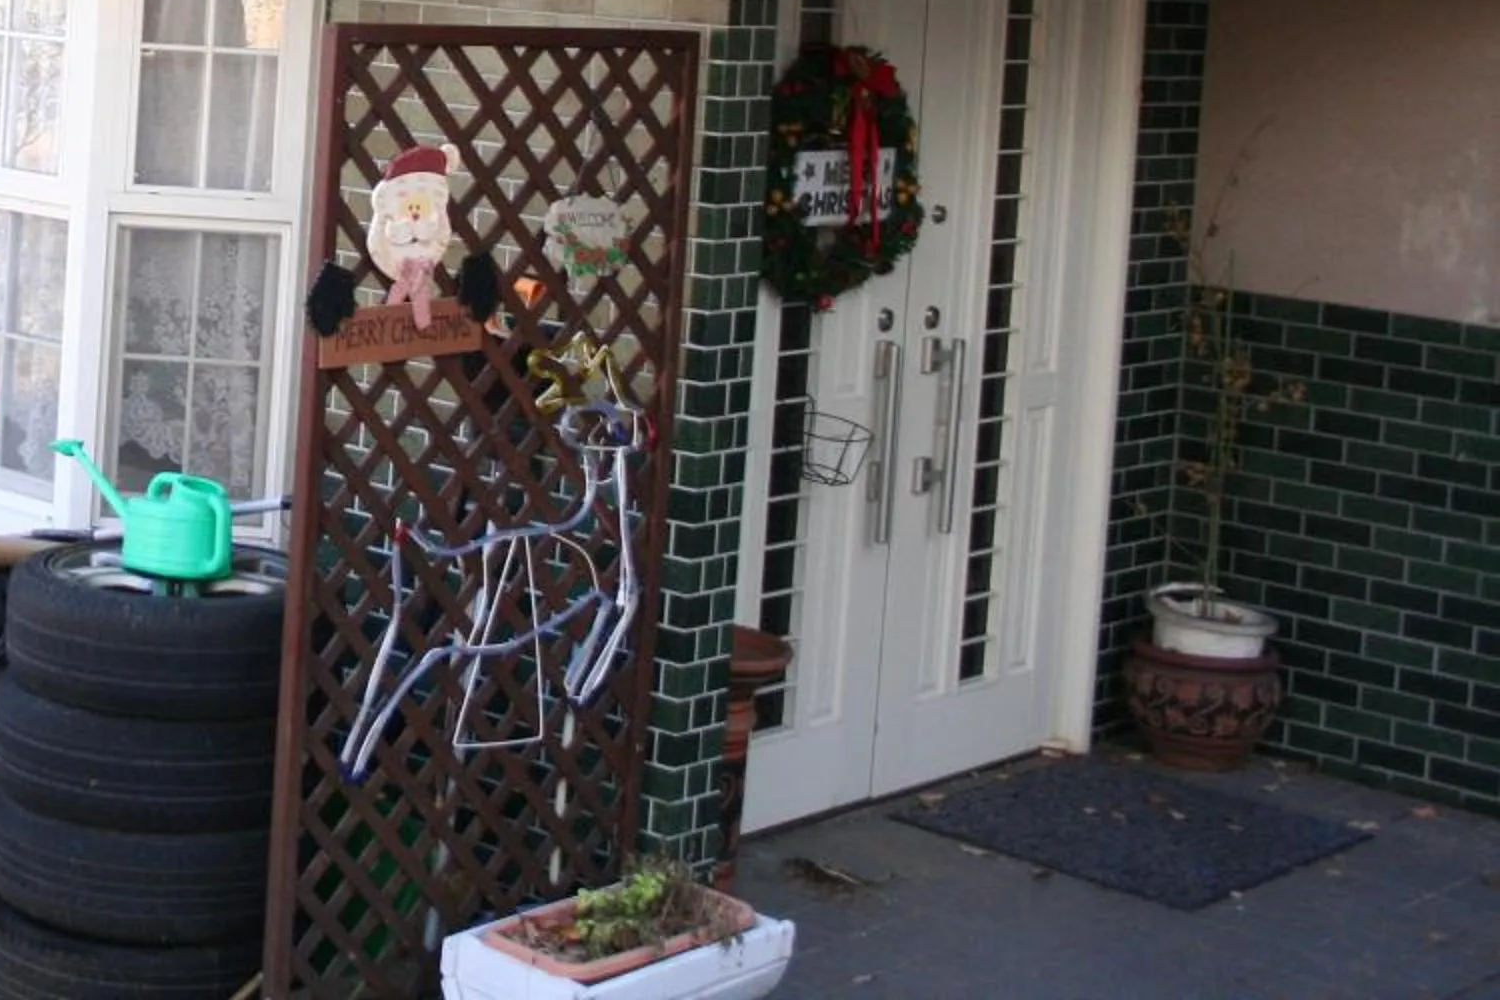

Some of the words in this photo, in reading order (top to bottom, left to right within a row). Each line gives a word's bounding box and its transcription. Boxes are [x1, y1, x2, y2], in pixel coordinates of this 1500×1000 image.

[800, 186, 892, 216] CHRISS
[336, 316, 389, 351] MERRY
[391, 312, 471, 344] CHSTMAS
